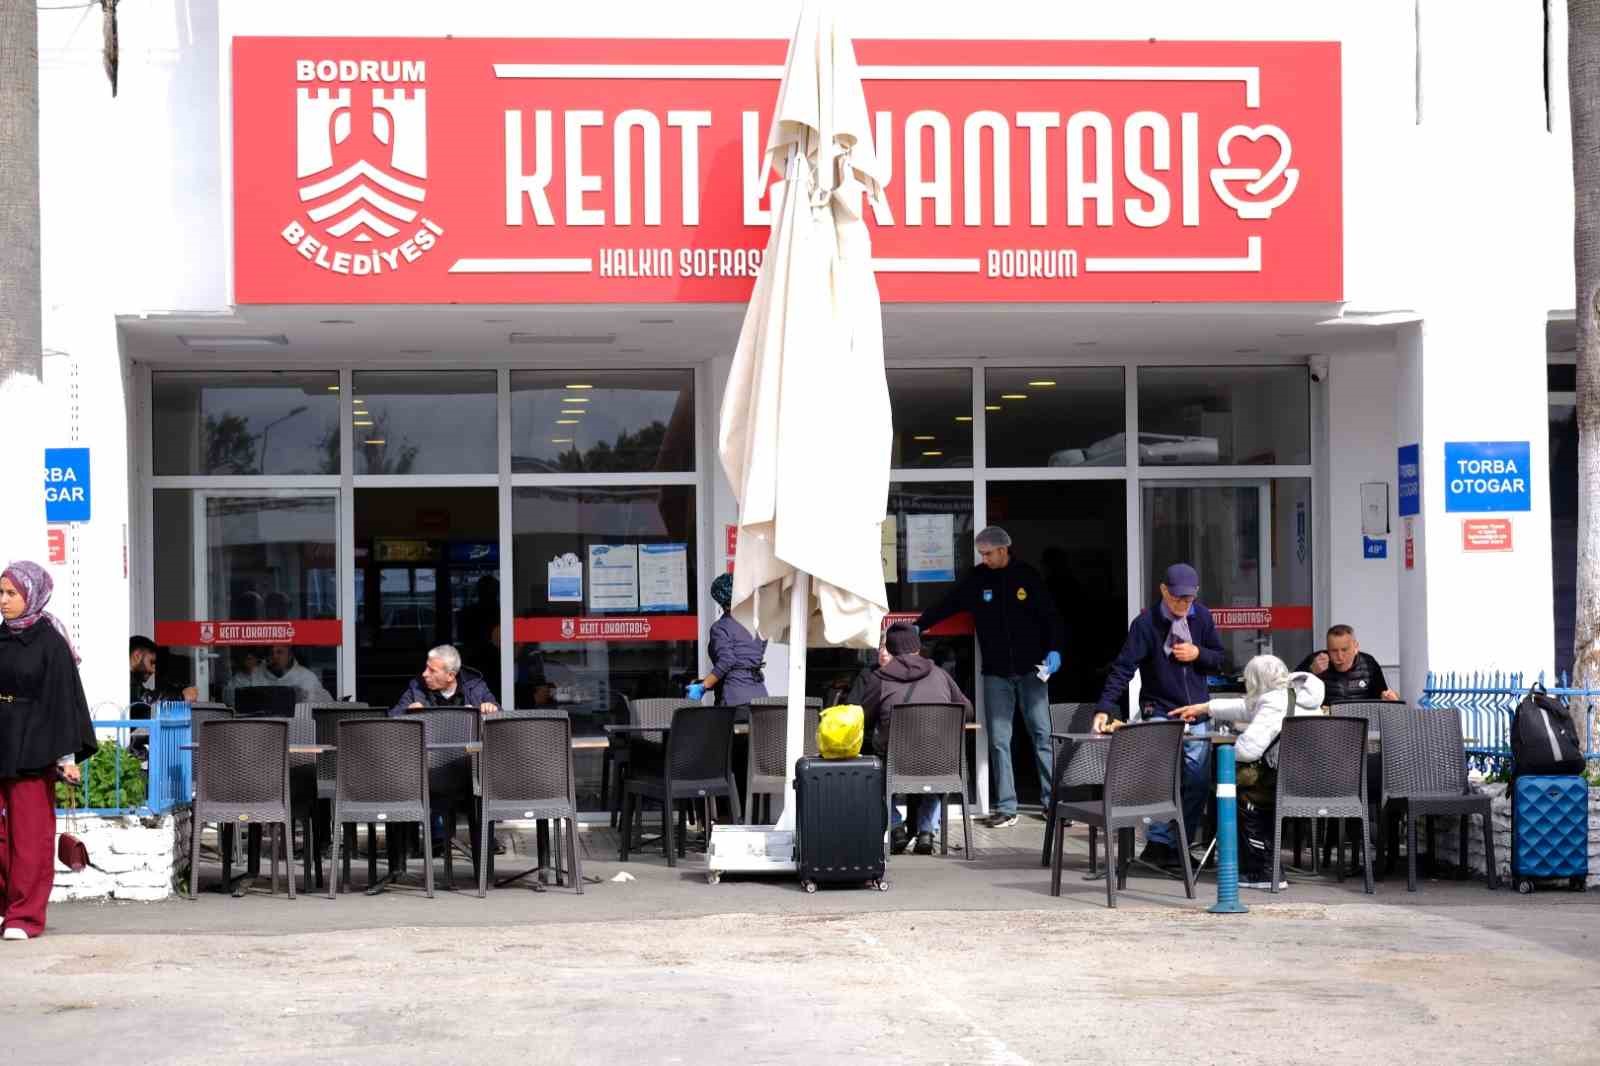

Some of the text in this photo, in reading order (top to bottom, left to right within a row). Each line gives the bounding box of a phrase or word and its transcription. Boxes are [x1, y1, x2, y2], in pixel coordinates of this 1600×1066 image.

[296, 59, 426, 82] BODRUM
[504, 108, 1200, 228] KENT LKANTASI
[281, 217, 444, 276] BELEDİYESİ
[599, 247, 766, 278] HALKIN SOFRAS
[986, 248, 1078, 278] BODRUM
[1457, 459, 1518, 474] TORBA
[45, 487, 85, 502] GAR
[1450, 479, 1525, 494] OTOGAR
